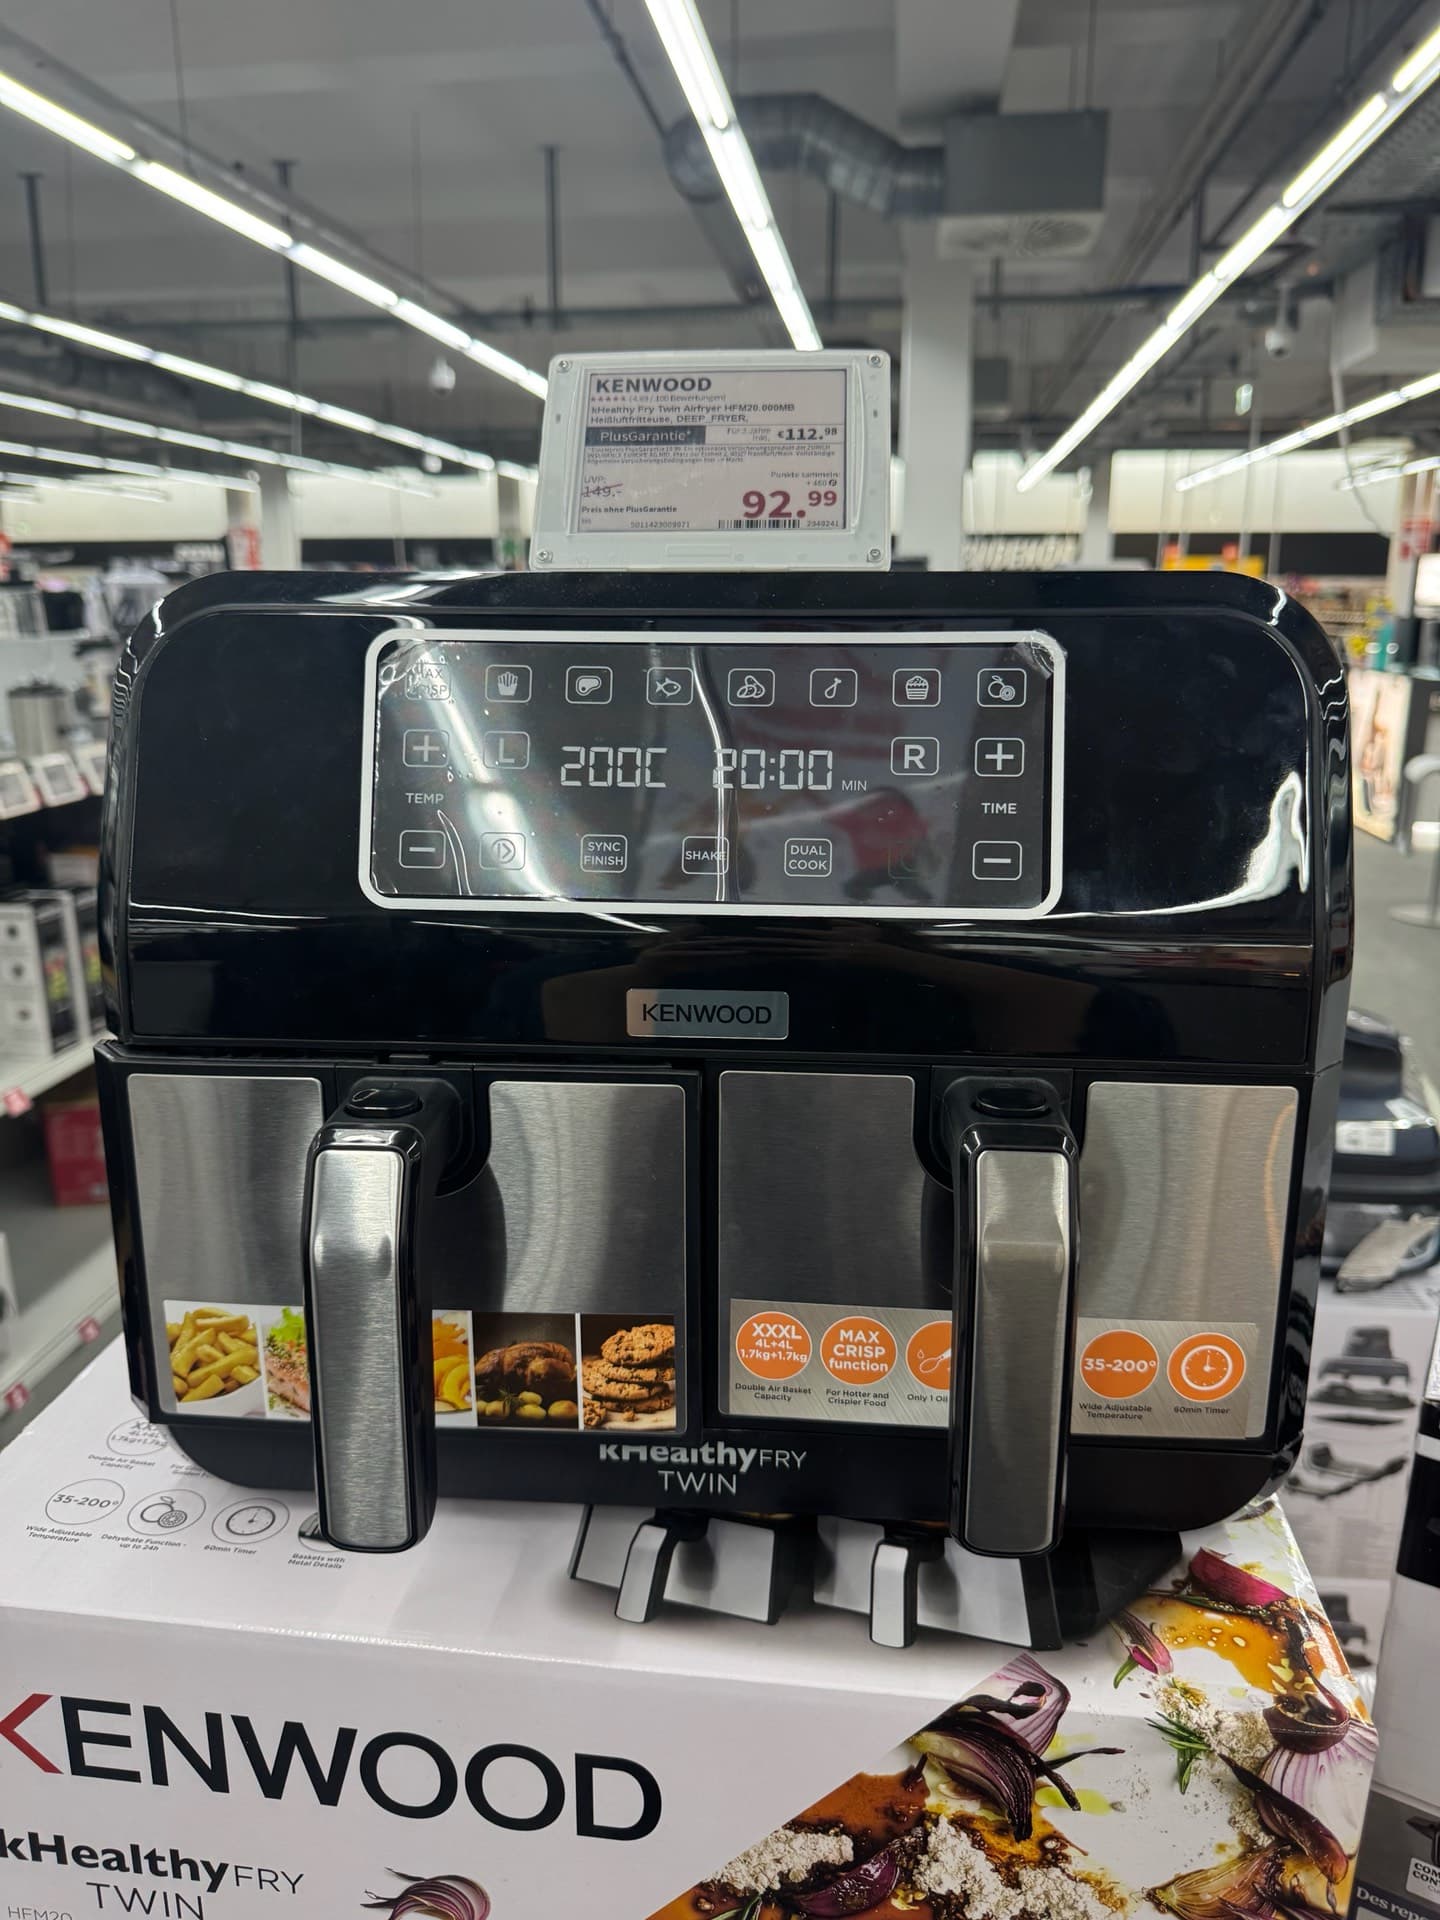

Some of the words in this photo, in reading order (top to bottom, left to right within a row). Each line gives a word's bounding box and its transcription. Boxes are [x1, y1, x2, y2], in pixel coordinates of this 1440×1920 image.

[596, 377, 712, 393] KENWOOD
[638, 406, 655, 414] Fry
[659, 405, 680, 413] Twin
[683, 403, 721, 413] Airfryer
[777, 427, 838, 441] €112.98
[626, 505, 677, 513] PlusGarantie
[742, 490, 837, 519] 92.99
[498, 738, 515, 763] L
[904, 744, 926, 770] R
[712, 749, 833, 790] 20:00
[841, 780, 867, 792] MIN
[405, 792, 444, 804] TEMP
[981, 803, 1017, 815] TIME
[588, 842, 621, 852] SYNC
[791, 845, 827, 856] DUAL
[584, 856, 624, 866] FINISH
[685, 850, 727, 860] SHAKE
[789, 859, 827, 870] COOK
[642, 1003, 772, 1024] KENWOOD
[752, 1322, 802, 1340] XXXL
[839, 1329, 879, 1344] MAX
[755, 1338, 793, 1350] 4L+4L
[739, 1348, 808, 1362] 1.7kg+1.7kg
[832, 1344, 886, 1359] CRISP
[829, 1357, 888, 1373] function
[735, 1383, 766, 1392] Double
[768, 1384, 781, 1393] Air
[783, 1386, 812, 1395] Basket
[826, 1388, 841, 1396] For
[843, 1389, 870, 1399] Hotter
[872, 1391, 889, 1399] and
[754, 1392, 792, 1402] Capacity
[828, 1397, 861, 1407] Crispier
[864, 1399, 887, 1408] Food
[907, 1393, 928, 1403] Only
[1079, 1402, 1103, 1410] Wide
[1104, 1404, 1152, 1412] Adjustable
[1174, 1406, 1202, 1414] 60min
[1205, 1406, 1230, 1415] Timer
[1087, 1411, 1143, 1420] Temperature
[100, 1462, 134, 1470] Capacity
[658, 1470, 737, 1495] TWIN
[26, 1525, 47, 1533] Wide
[49, 1528, 93, 1538] Adjustable
[28, 1531, 80, 1543] Temperature
[101, 1533, 145, 1545] Dehydrate
[146, 1538, 182, 1548] Function
[142, 1544, 159, 1552] 24h
[204, 1544, 231, 1552] 60min
[233, 1546, 257, 1555] Timer
[292, 1553, 325, 1561] Baskets
[313, 1561, 343, 1569] Details
[1412, 1870, 1440, 1887] CON
[86, 1881, 204, 1920] TWIN
[1356, 1886, 1389, 1910] Des
[7, 1905, 73, 1920] HFM20
